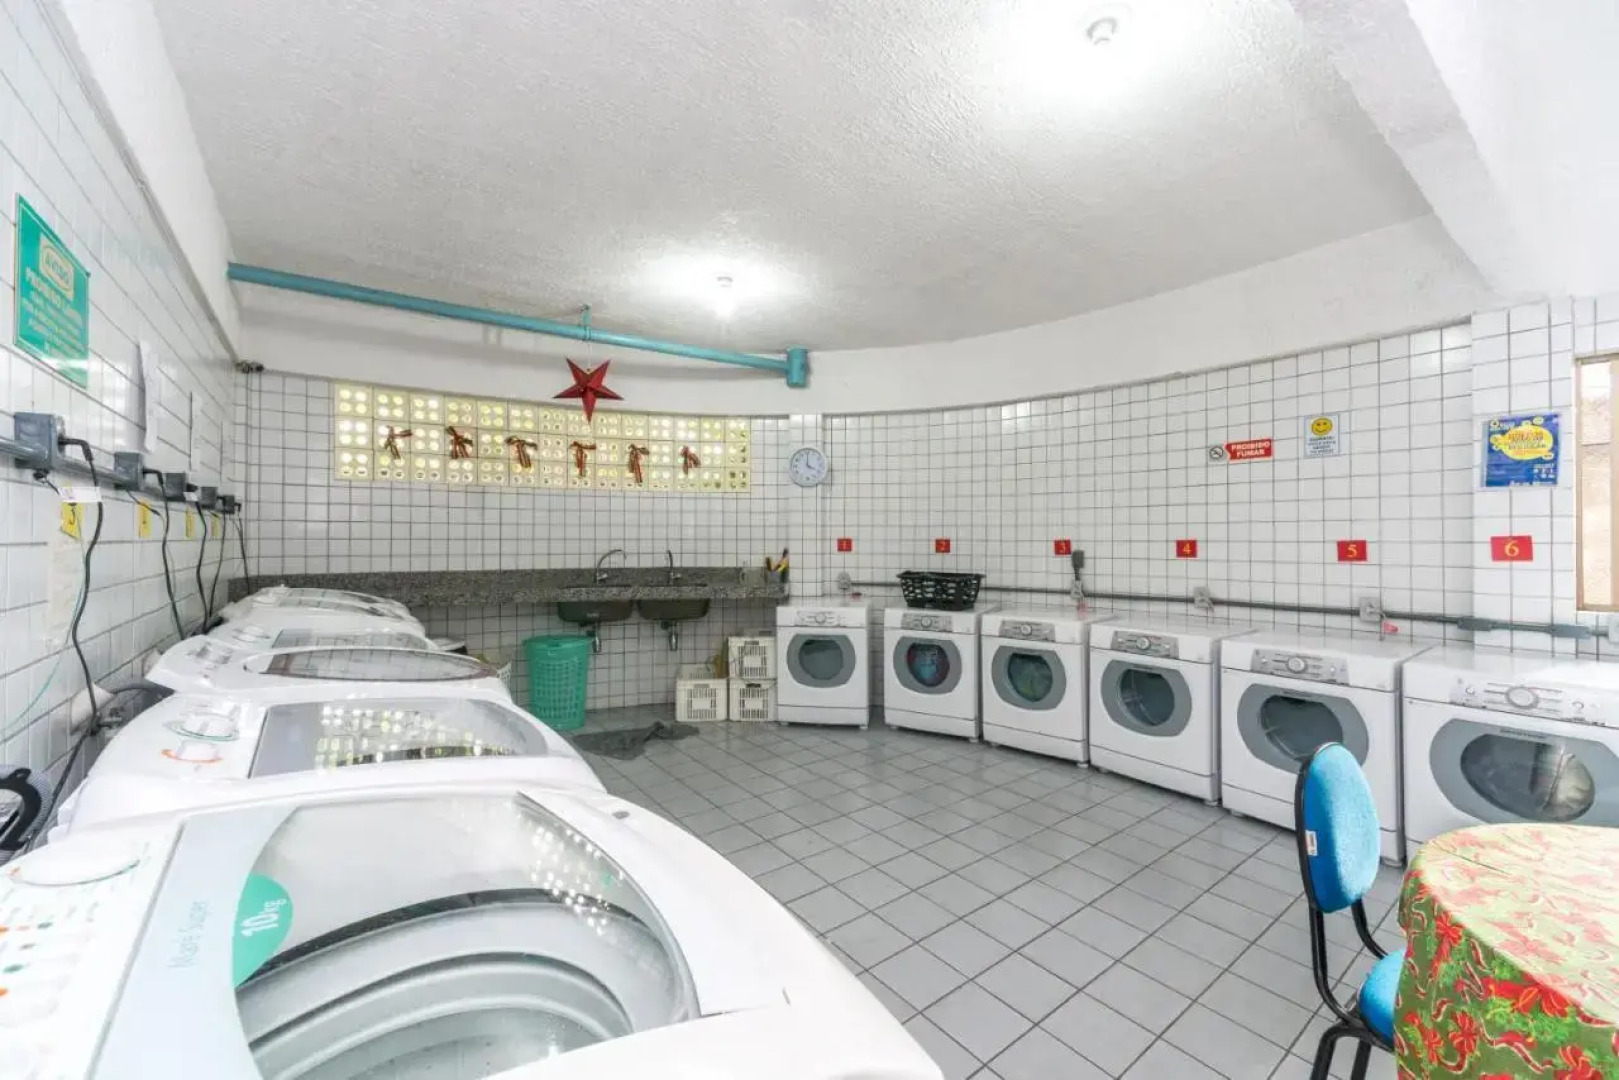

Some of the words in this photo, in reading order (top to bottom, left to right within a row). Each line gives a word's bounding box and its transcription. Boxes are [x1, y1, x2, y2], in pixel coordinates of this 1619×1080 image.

[1231, 440, 1271, 451] PROIBIDO
[1236, 449, 1265, 458] FUMAR
[1058, 541, 1067, 553] 3
[1182, 543, 1191, 555] 4
[1346, 544, 1357, 558] 5
[1504, 540, 1520, 557] 6
[241, 898, 288, 937] 10kg
